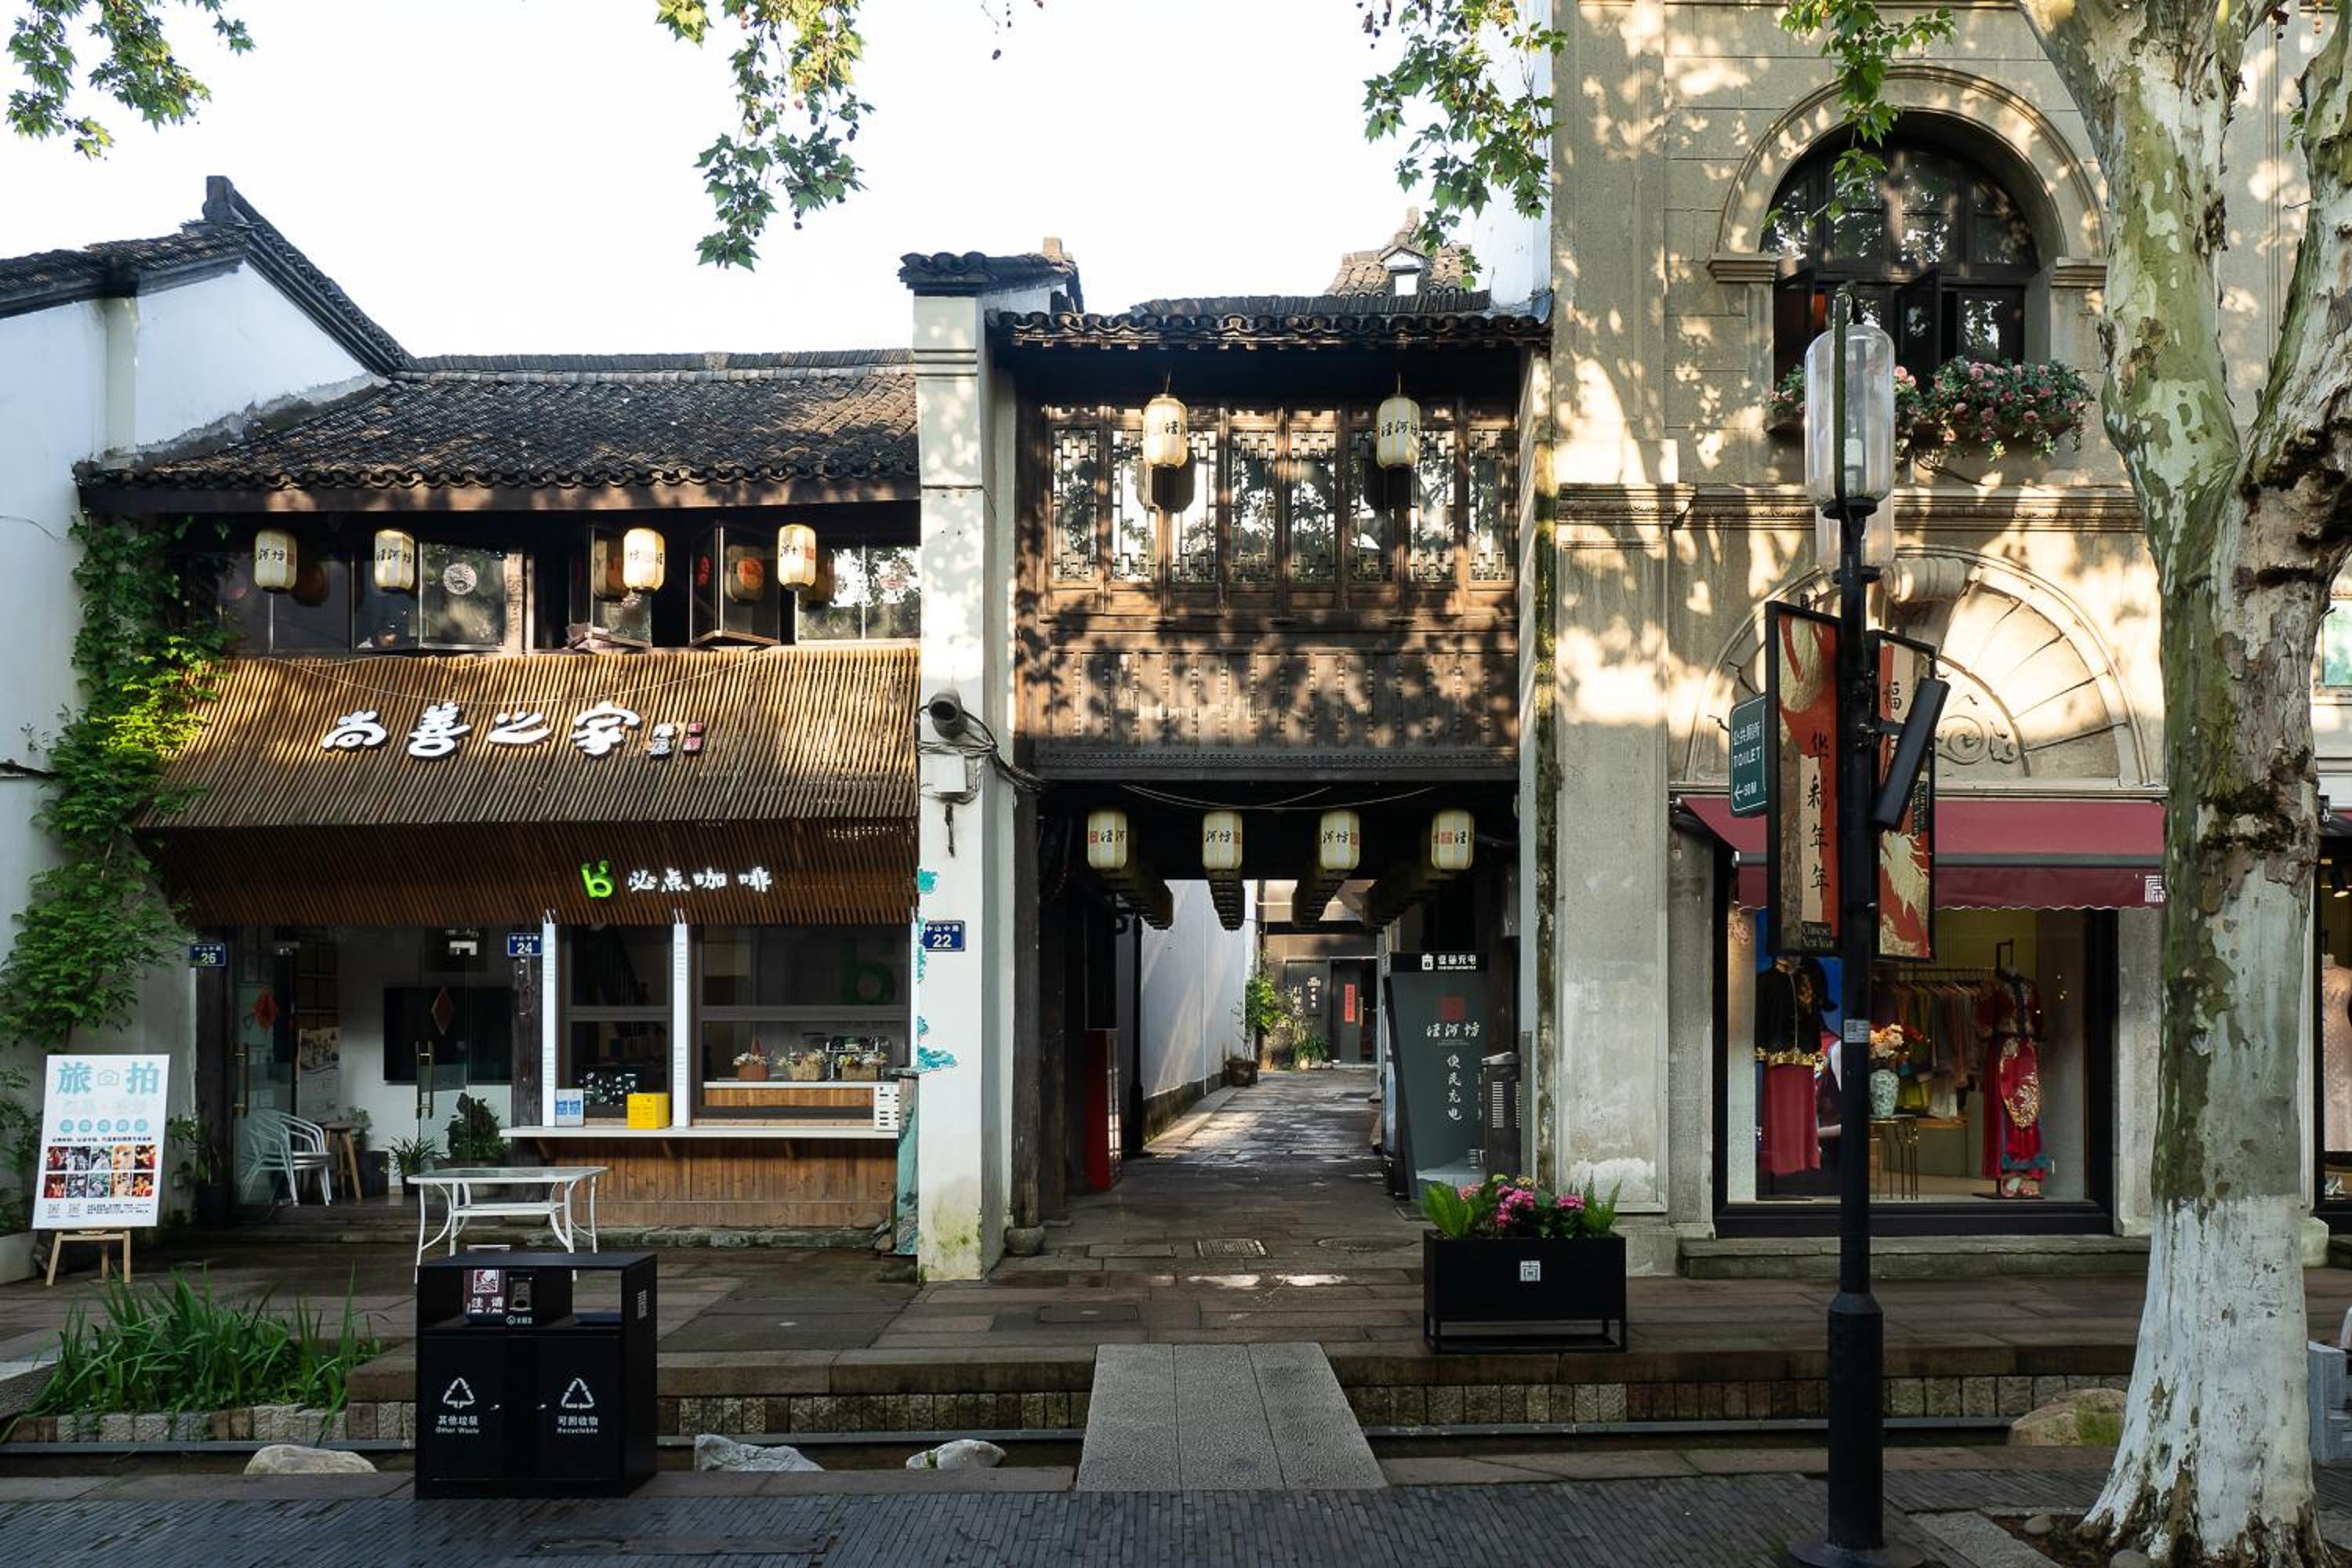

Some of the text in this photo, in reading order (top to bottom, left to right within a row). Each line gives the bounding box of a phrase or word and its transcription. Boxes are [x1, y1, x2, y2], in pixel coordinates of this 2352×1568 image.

[322, 702, 641, 757] 尚善之家
[1733, 746, 1762, 768] TOILET
[628, 866, 772, 893] 必点咖啡
[517, 942, 532, 954] 24
[933, 934, 952, 948] 22
[201, 953, 216, 964] 26
